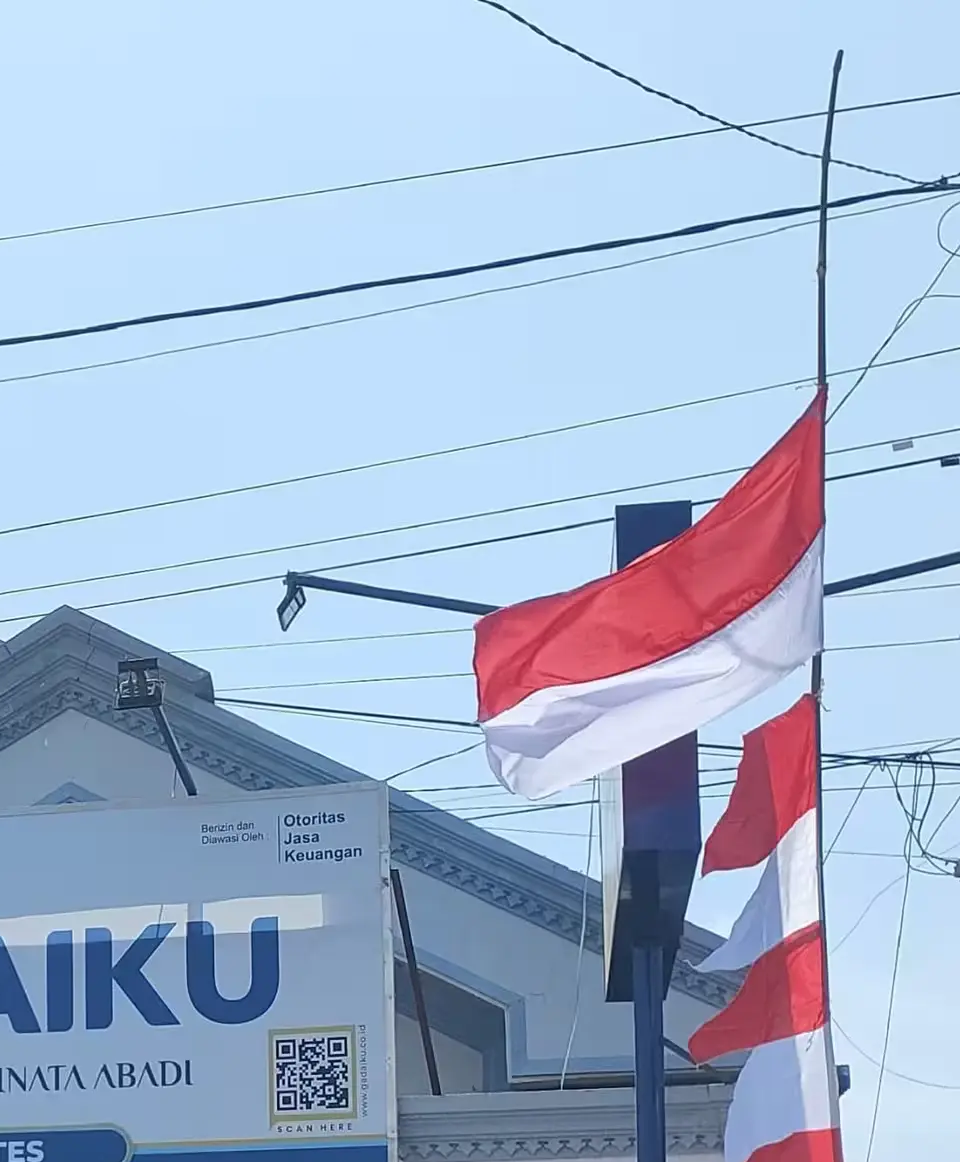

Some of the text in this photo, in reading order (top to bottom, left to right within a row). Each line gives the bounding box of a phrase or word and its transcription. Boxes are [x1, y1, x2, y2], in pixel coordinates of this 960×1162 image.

[236, 821, 255, 831] dan
[283, 812, 346, 827] Otoritas
[201, 833, 239, 845] Diawasi
[241, 831, 264, 842] Oleh
[283, 832, 320, 845] Jasa
[284, 846, 363, 863] Keuangan
[93, 1059, 193, 1089] ABADI
[358, 1024, 369, 1118] www.gadaiku.co.id
[277, 1122, 352, 1133] SCAN HERE
